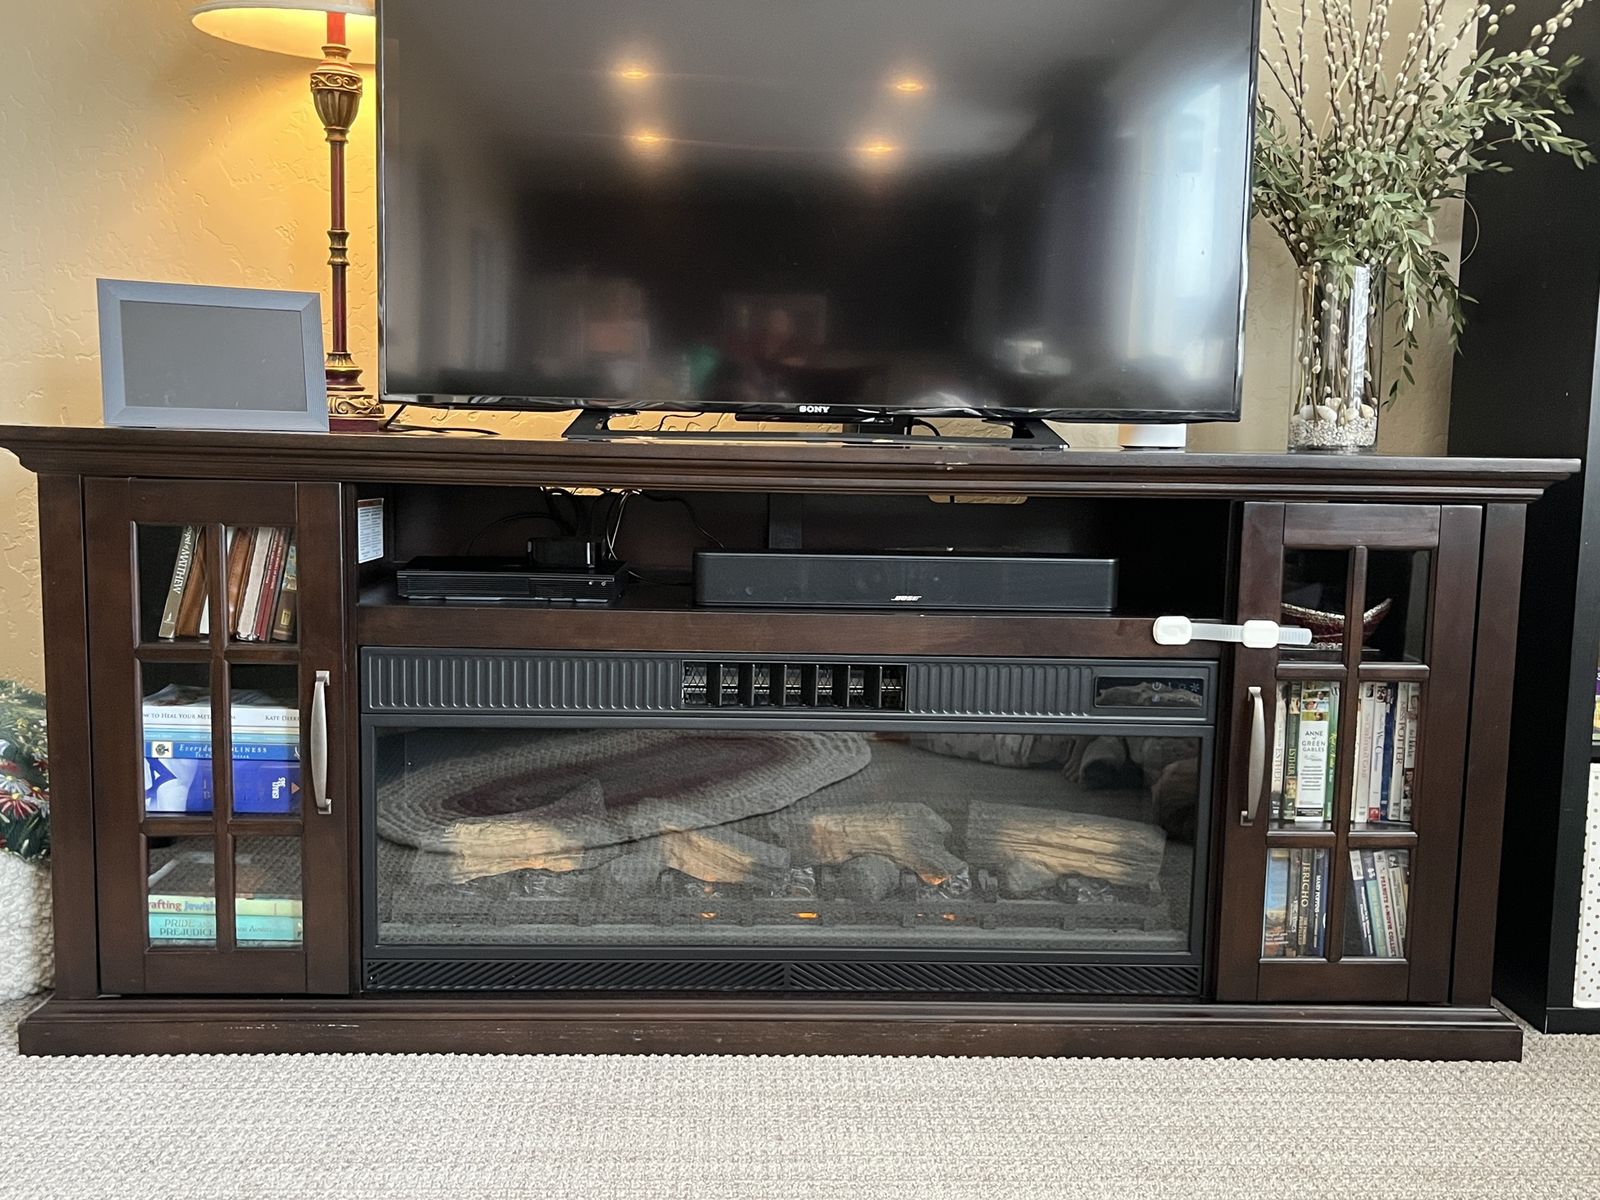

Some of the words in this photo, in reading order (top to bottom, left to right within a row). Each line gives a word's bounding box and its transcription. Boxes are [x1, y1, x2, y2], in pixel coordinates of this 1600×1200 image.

[799, 405, 830, 414] SONY
[173, 549, 192, 594] MATTHEW
[1395, 723, 1406, 765] POTTER
[1273, 748, 1283, 783] ESTHER
[1287, 748, 1297, 777] ESTHER
[1301, 862, 1310, 907] JERICHO
[1380, 876, 1389, 904] PEANUTS
[149, 899, 182, 912] afting
[160, 928, 214, 937] PREJUDICE
[165, 919, 195, 928] PRIDE
